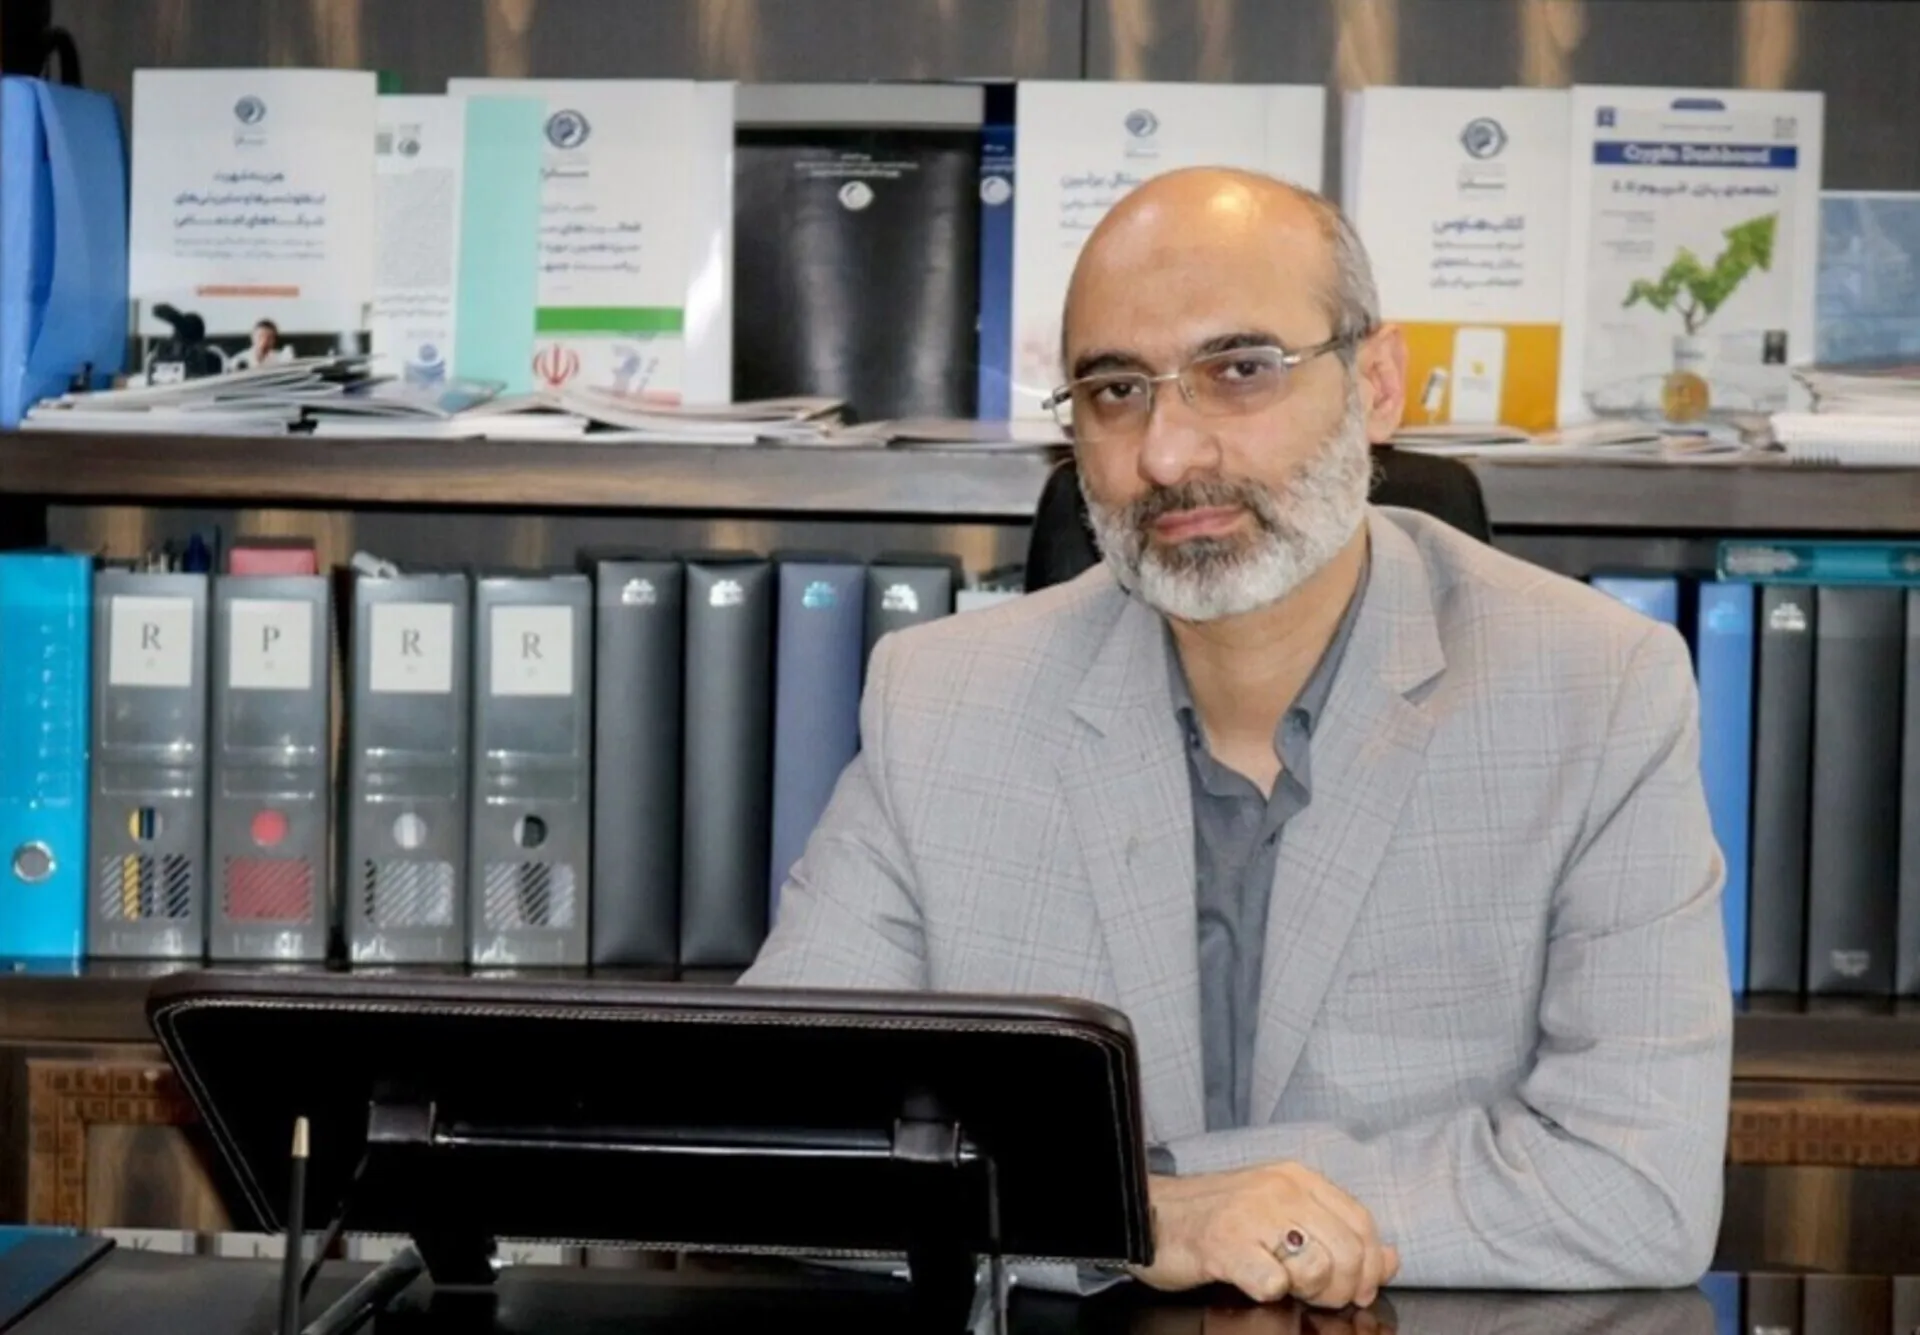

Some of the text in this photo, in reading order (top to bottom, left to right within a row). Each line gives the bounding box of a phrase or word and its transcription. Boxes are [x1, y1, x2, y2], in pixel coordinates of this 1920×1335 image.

[1623, 144, 1770, 165] Crypto Dashboard
[141, 622, 162, 651] R
[262, 624, 281, 652] P
[401, 628, 423, 657] R
[521, 630, 543, 659] R
